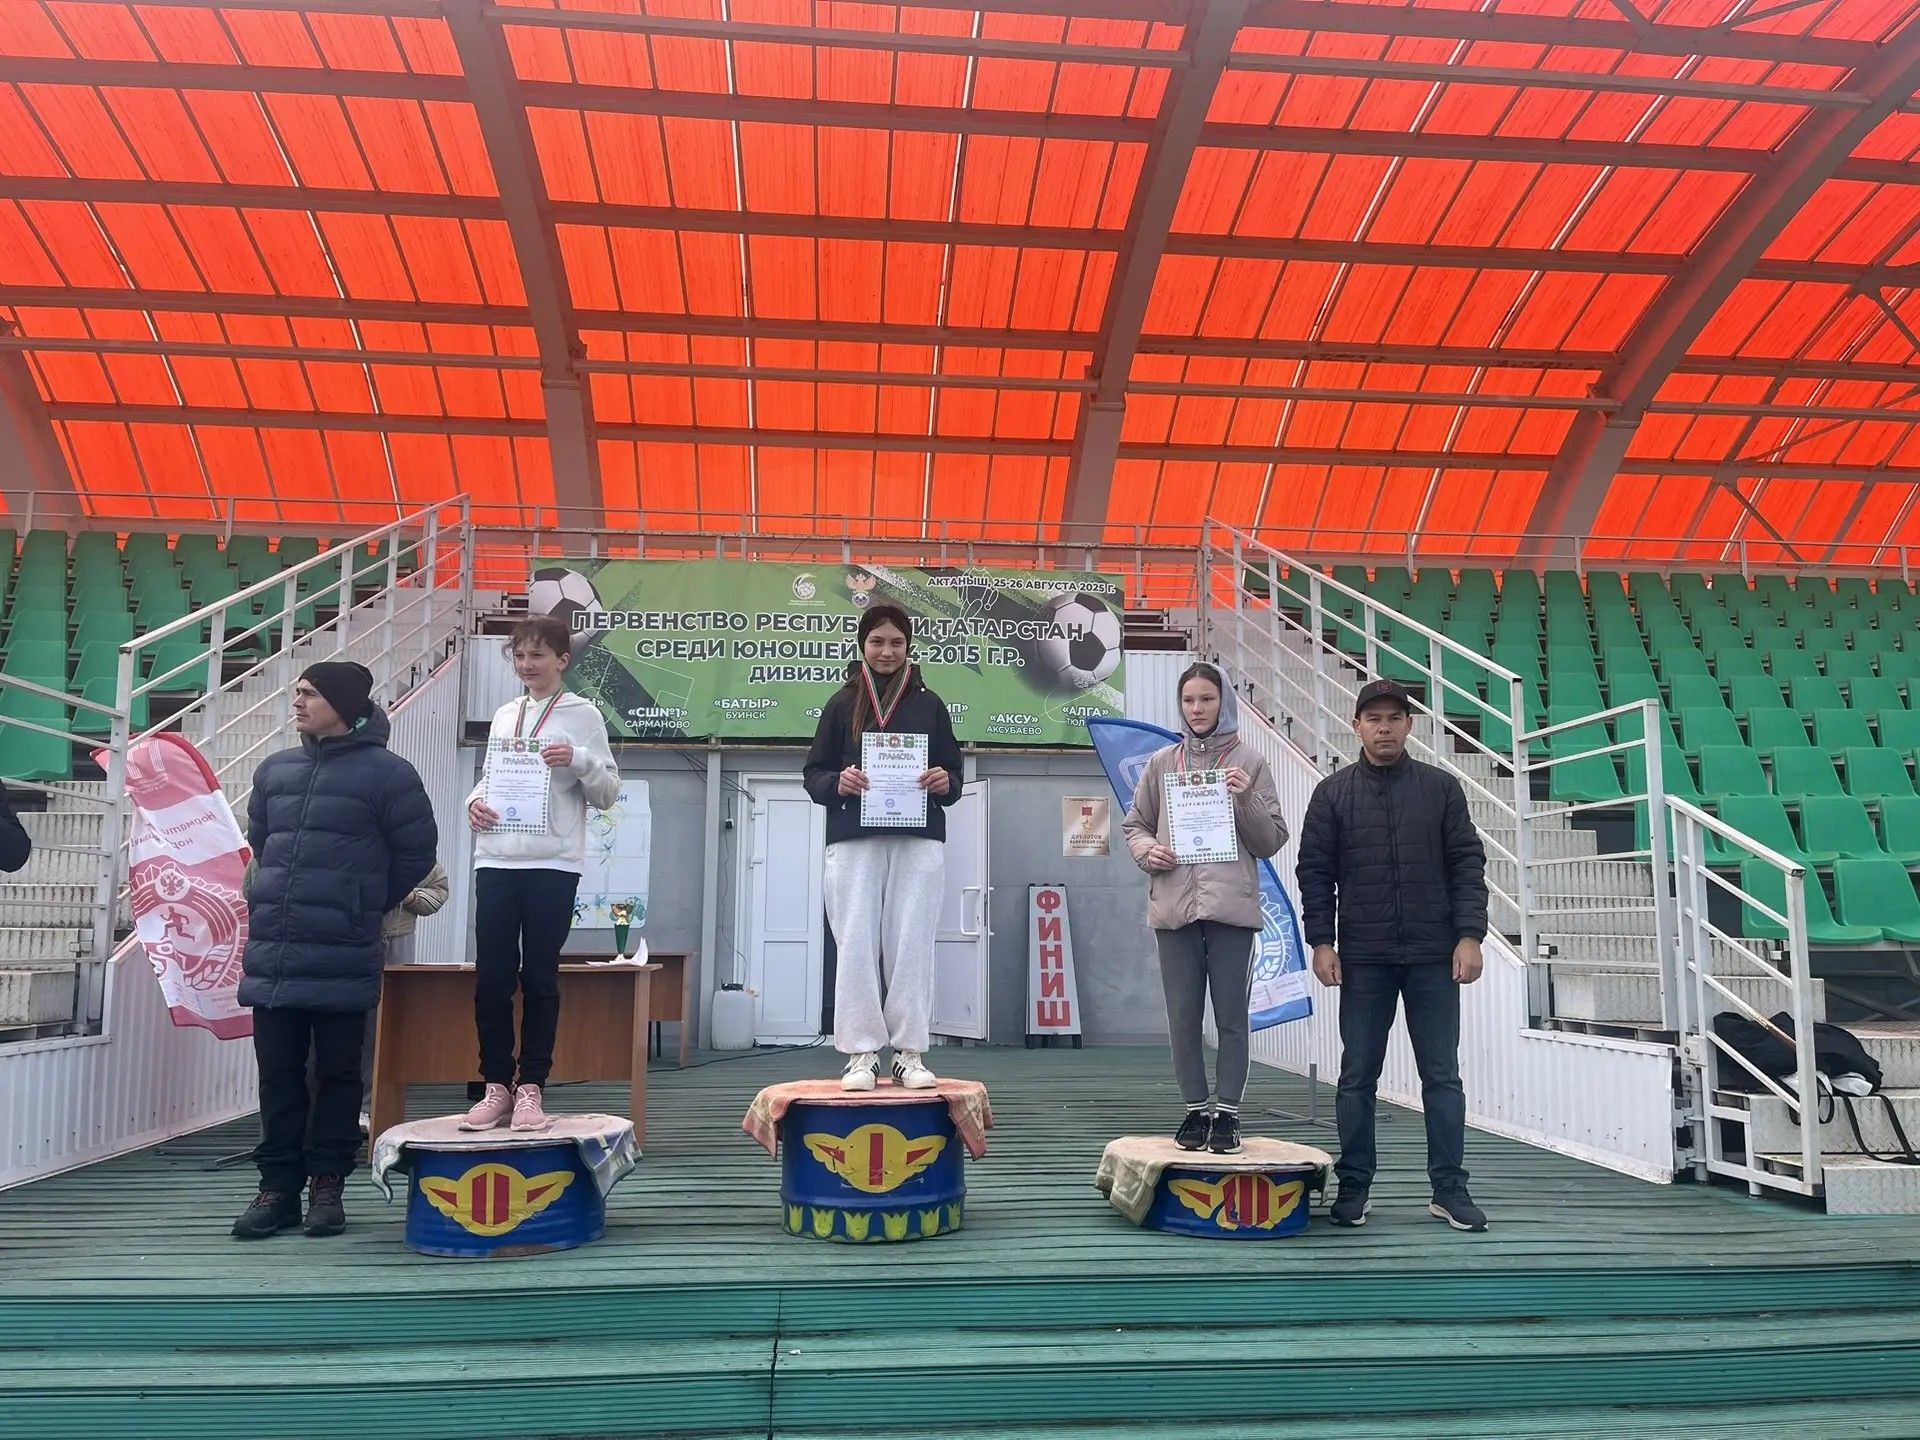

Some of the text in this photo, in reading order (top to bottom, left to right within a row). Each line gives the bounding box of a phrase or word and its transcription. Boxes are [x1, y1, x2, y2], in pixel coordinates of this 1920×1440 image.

[927, 576, 991, 589] АКТАНЫШ,
[993, 578, 1024, 589] 25-26
[1025, 580, 1077, 591] АВГУСТА
[1079, 582, 1106, 593] 2025
[572, 610, 1084, 641] ПЕРВЕНСТВО РЕСПУБИ ТАТАРСТАН
[636, 638, 726, 661] СРЕДИ
[733, 637, 859, 661] ЮНОШЕЙ
[987, 646, 1026, 667] Г.Р.
[749, 666, 848, 684] ДИВИЗИ
[714, 698, 779, 709] «БАТЫР»
[725, 711, 766, 720] БУИНСК
[1062, 706, 1109, 717] «АЛГА»
[624, 719, 690, 729] САРМАНОВО
[989, 713, 1039, 724] «АКСУ»
[986, 725, 1042, 735] АКСУБАЕВО
[1036, 890, 1071, 1027] ФИНИШ
